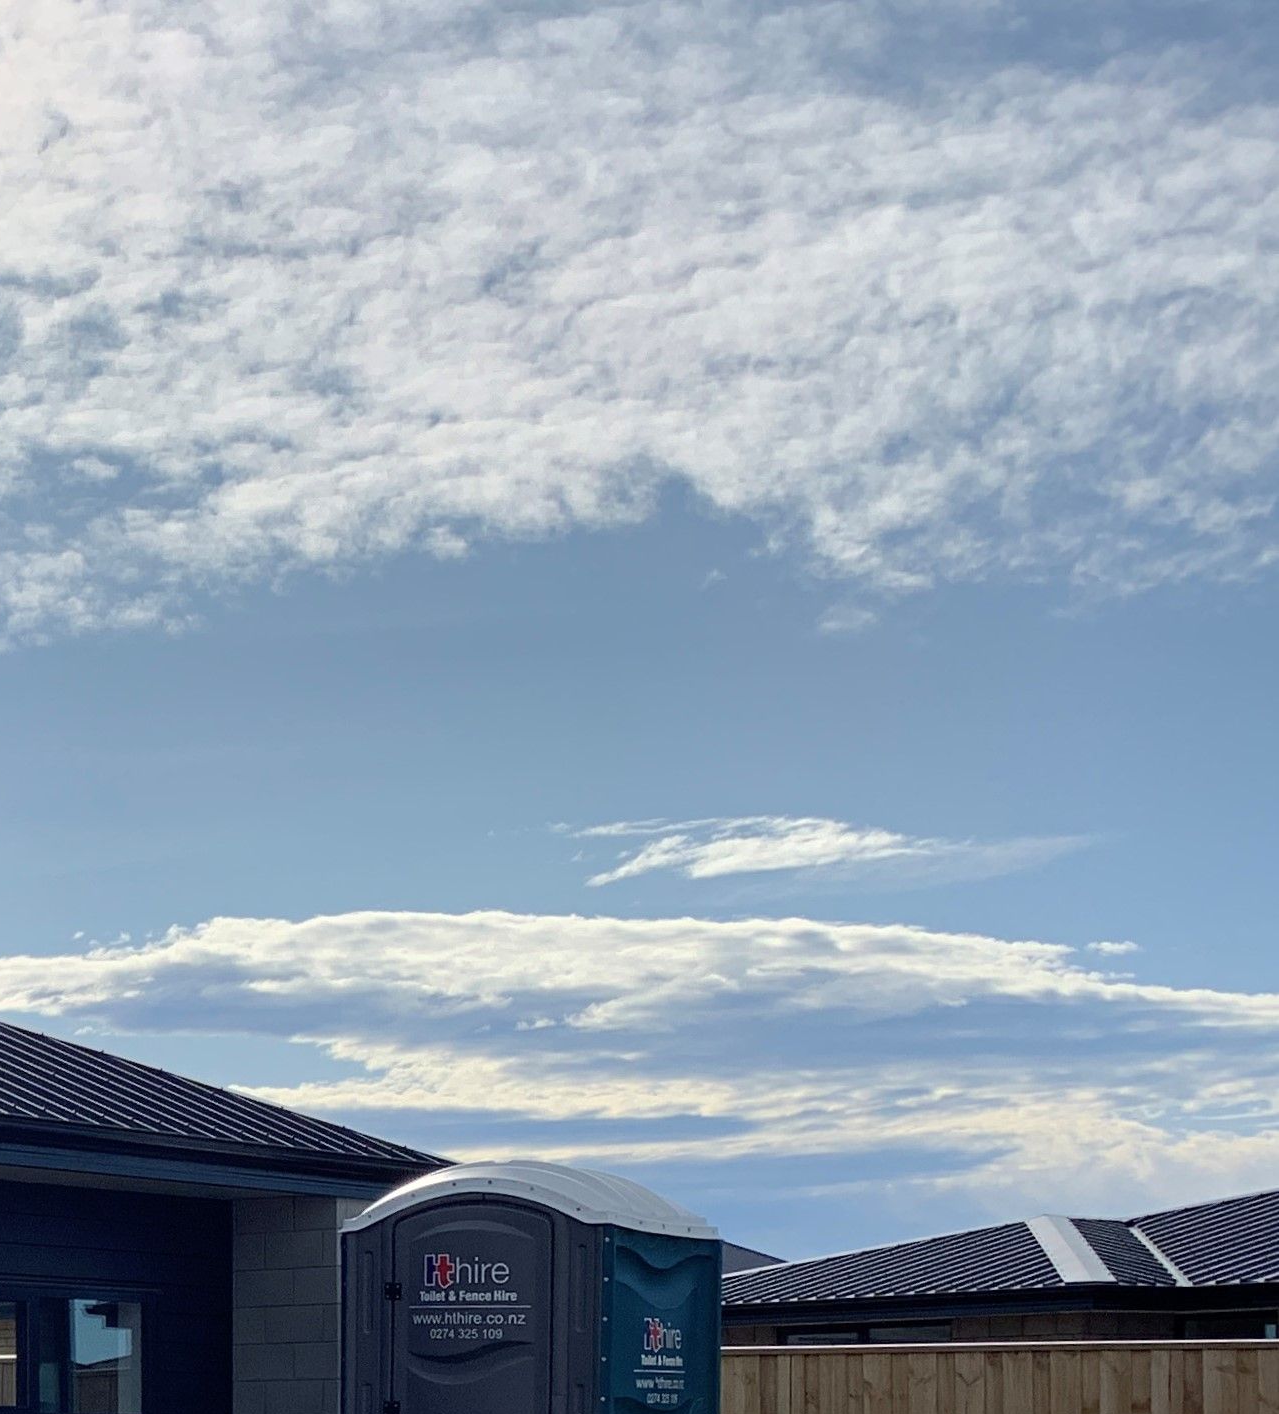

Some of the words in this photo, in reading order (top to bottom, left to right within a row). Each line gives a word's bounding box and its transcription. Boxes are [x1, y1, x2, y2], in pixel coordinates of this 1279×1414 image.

[420, 1291, 446, 1302] Toilet
[449, 1290, 456, 1302] &
[459, 1290, 492, 1302] Fence
[494, 1290, 518, 1302] Hire
[412, 1312, 527, 1325] www.hthire.co.nz
[430, 1329, 455, 1340] 0274
[458, 1329, 479, 1340] 325
[482, 1328, 503, 1340] 109
